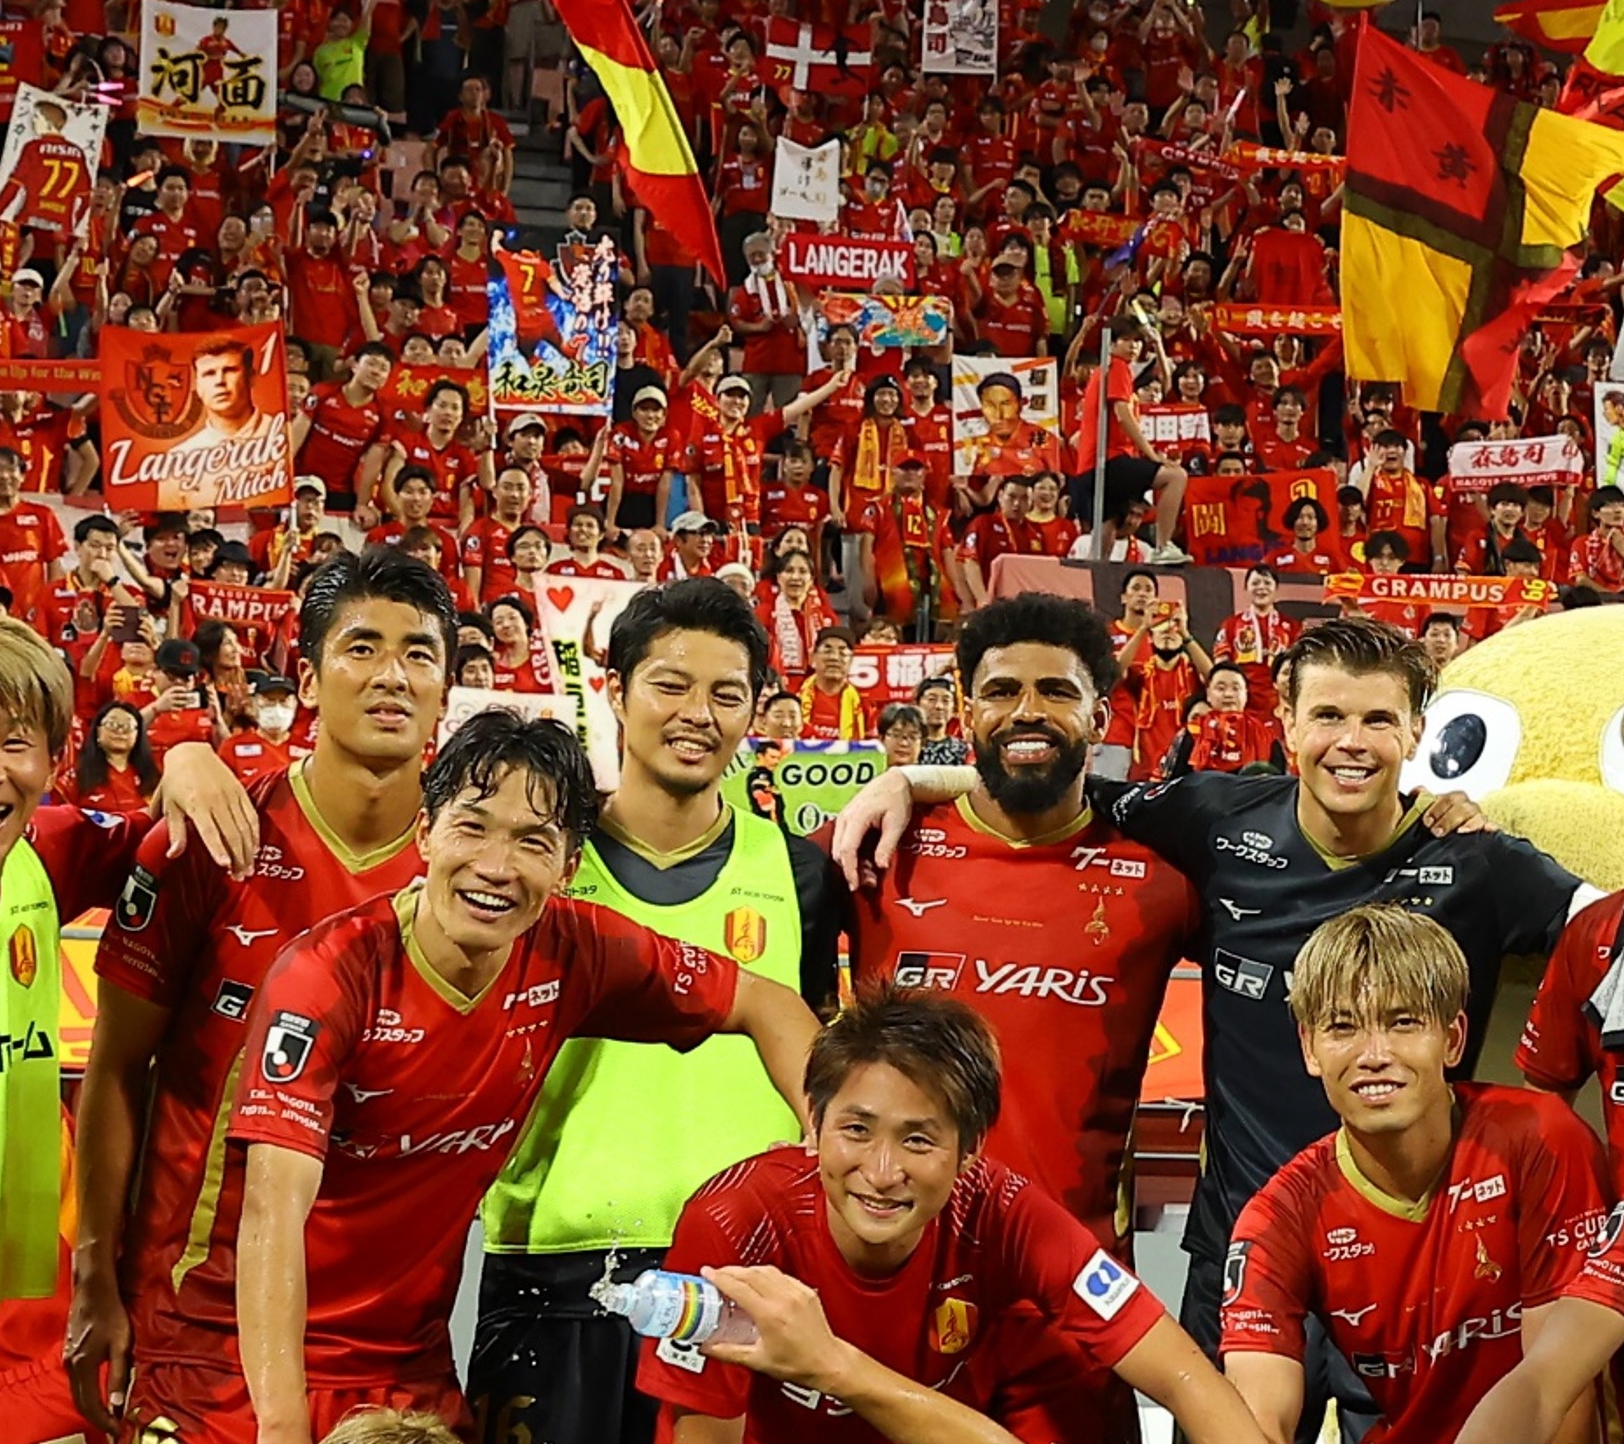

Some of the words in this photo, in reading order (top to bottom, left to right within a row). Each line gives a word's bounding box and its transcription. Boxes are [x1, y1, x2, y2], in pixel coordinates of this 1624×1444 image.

[149, 47, 267, 114] 河面
[39, 158, 80, 199] 77
[519, 265, 536, 292] 7
[788, 242, 908, 280] LANGERAK
[109, 412, 289, 490] Langerak
[214, 461, 289, 505] Mitch
[1372, 581, 1504, 603] GRAMPUS
[781, 761, 876, 787] GOOD
[1216, 836, 1289, 871] ワークスタッフ
[257, 863, 305, 881] スタッフ
[895, 965, 957, 991] GR
[1215, 962, 1265, 998] GR
